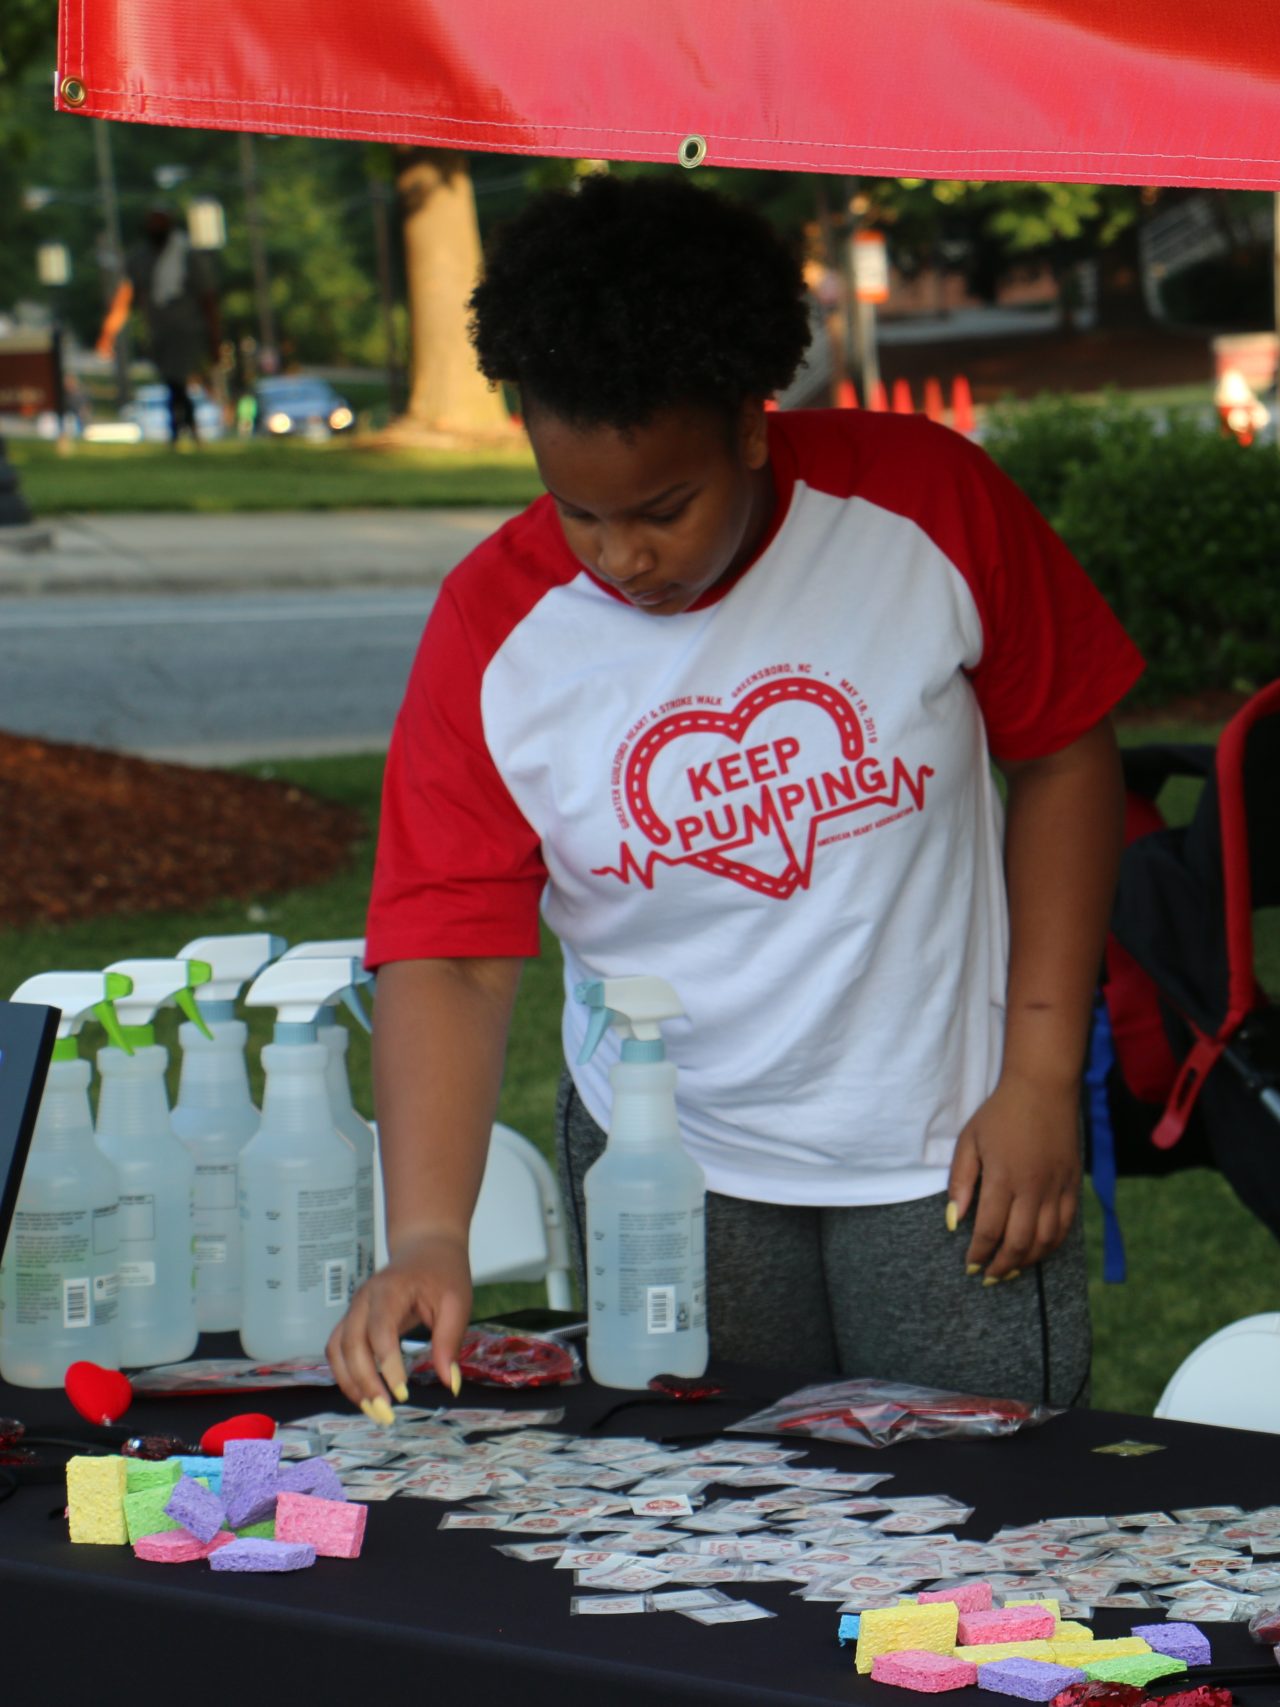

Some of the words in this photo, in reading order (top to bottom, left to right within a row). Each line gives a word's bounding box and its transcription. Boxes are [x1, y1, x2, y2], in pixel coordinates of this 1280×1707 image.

[798, 664, 812, 673] NC
[840, 679, 859, 697] MAY
[611, 742, 628, 785] GUILFORD
[626, 716, 648, 739] HEART
[659, 696, 692, 713] STROKE
[696, 695, 722, 705] WALK
[686, 737, 801, 802] KEEP
[675, 756, 888, 852] PUMPING
[817, 832, 851, 848] AMERICAN
[853, 824, 874, 839] HEART
[875, 806, 915, 830] ASSOCIATION
